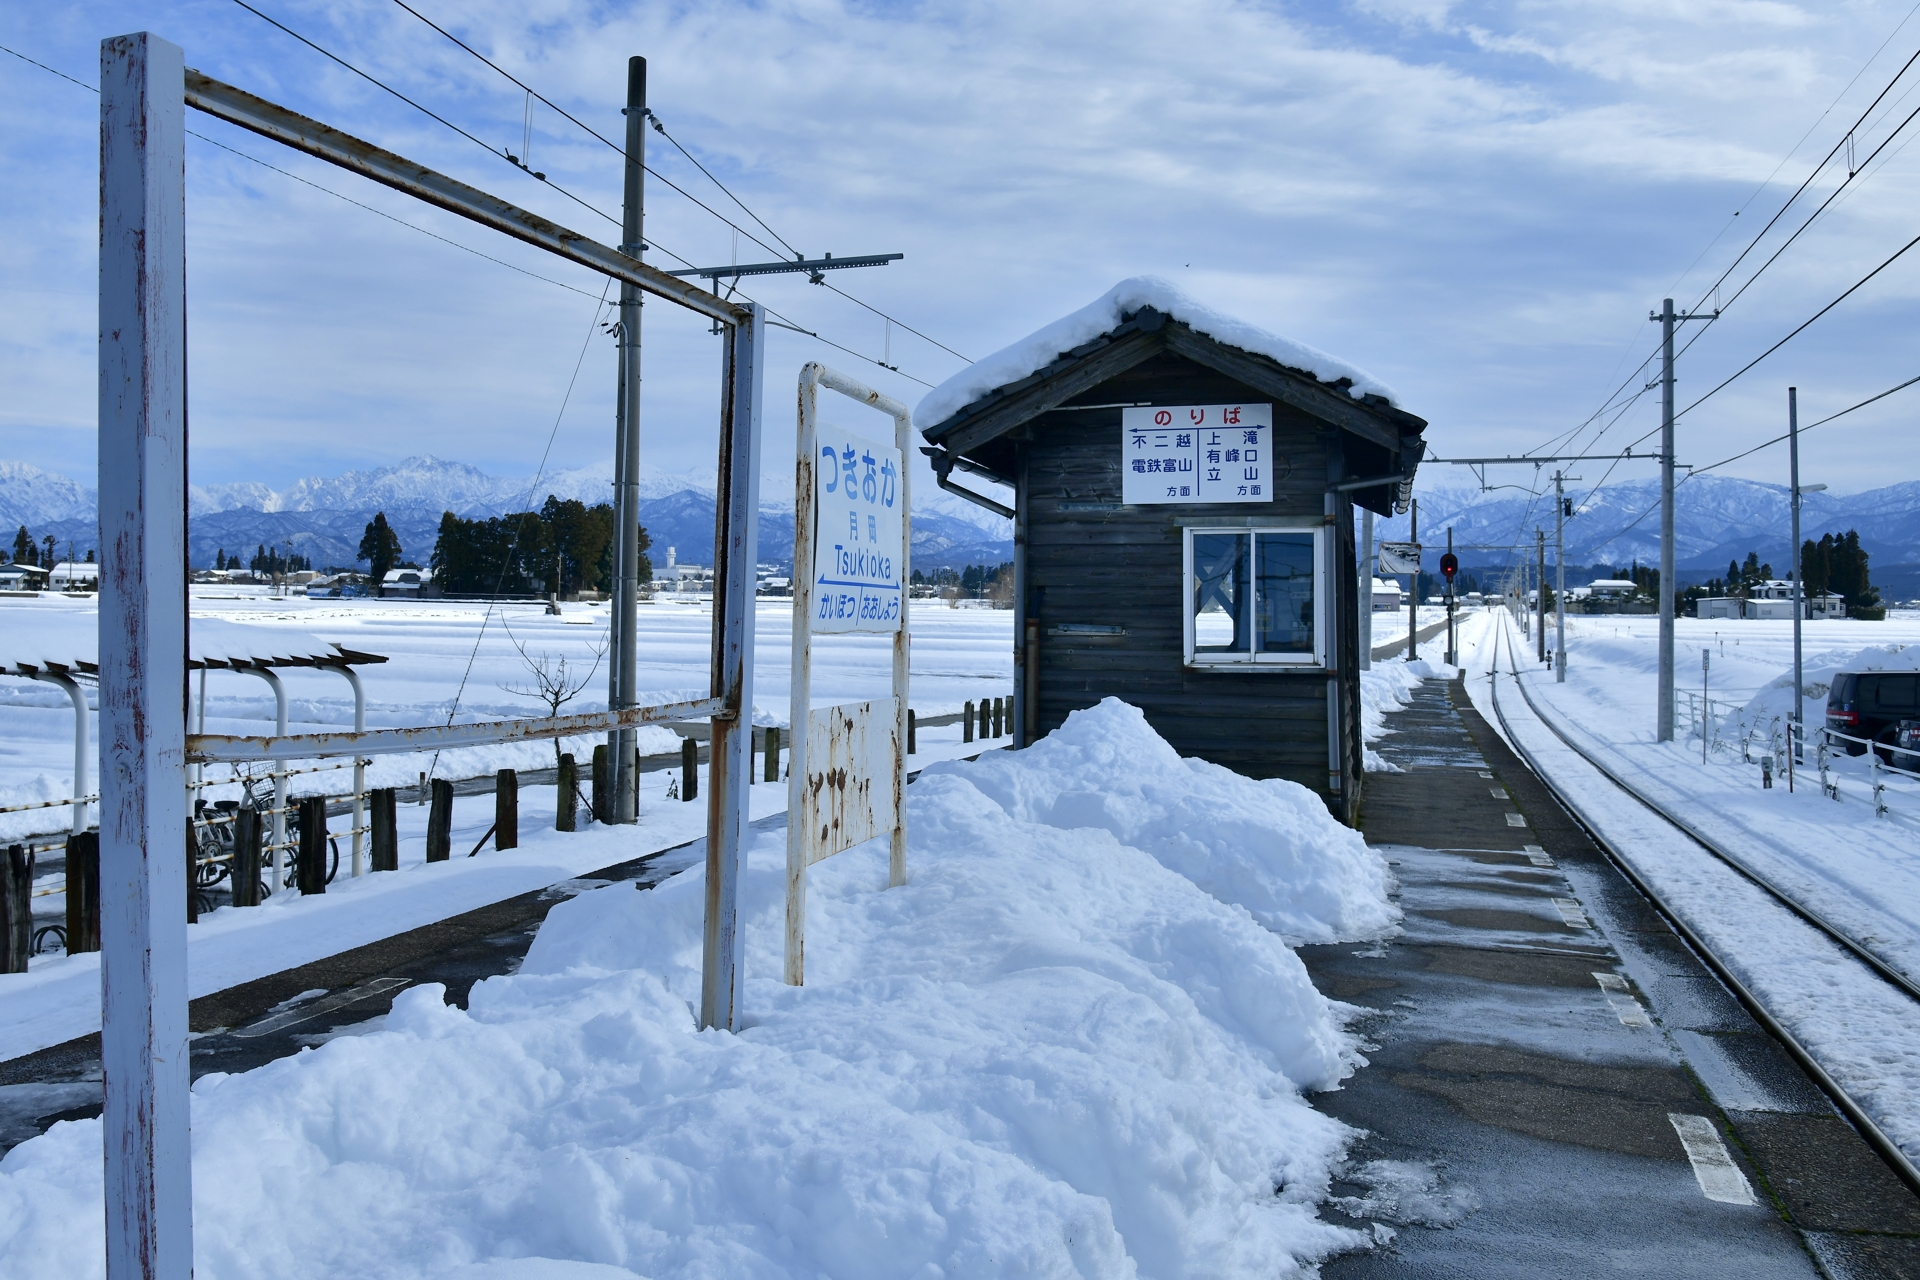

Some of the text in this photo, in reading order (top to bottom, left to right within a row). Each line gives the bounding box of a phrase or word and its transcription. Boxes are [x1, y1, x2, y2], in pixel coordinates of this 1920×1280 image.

[1154, 406, 1242, 426] のりば
[1132, 433, 1191, 449] 不二越
[1206, 430, 1259, 446] 上滝
[1206, 448, 1258, 464] 有峰口
[1131, 457, 1192, 474] 電鉄富山
[1206, 466, 1258, 481] 立山
[821, 443, 897, 508] つきおか
[1166, 485, 1191, 497] 方面
[1237, 484, 1262, 496] 方面
[849, 510, 877, 545] 月岡
[834, 544, 891, 580] Tsukioka
[818, 593, 856, 620] かいほつ
[860, 593, 899, 621] おおしょう
